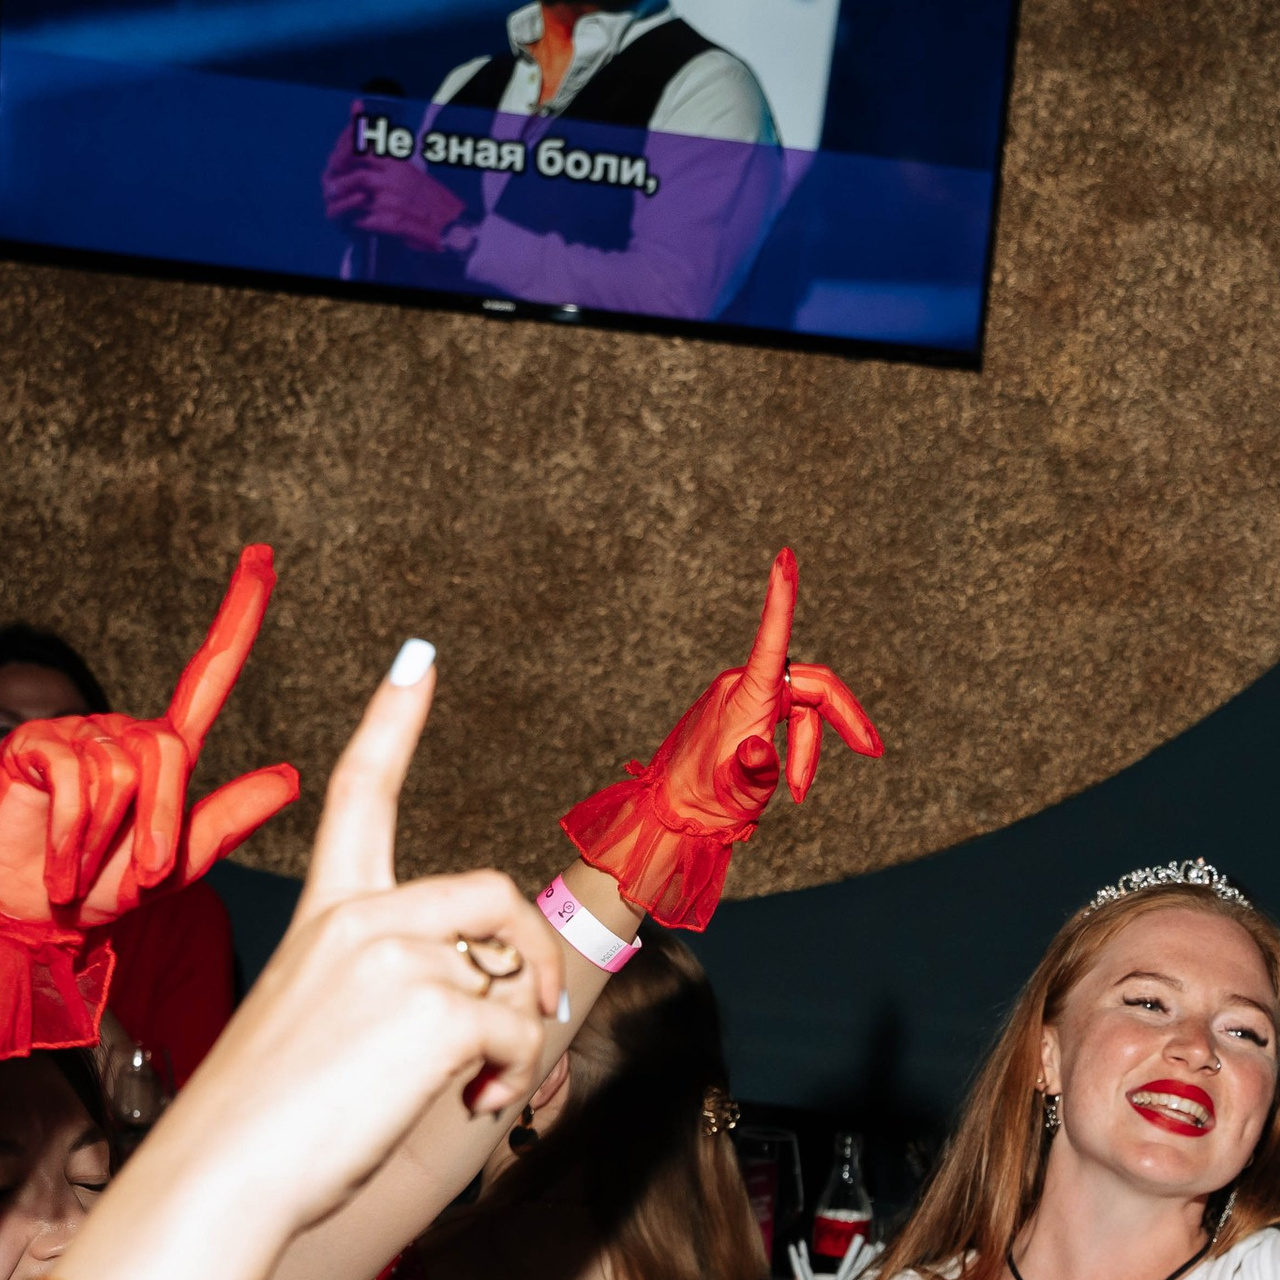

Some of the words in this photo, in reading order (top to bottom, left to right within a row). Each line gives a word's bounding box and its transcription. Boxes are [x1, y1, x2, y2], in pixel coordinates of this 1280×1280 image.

[357, 117, 413, 158] Не
[424, 132, 525, 172] зная
[537, 138, 658, 195] боли,
